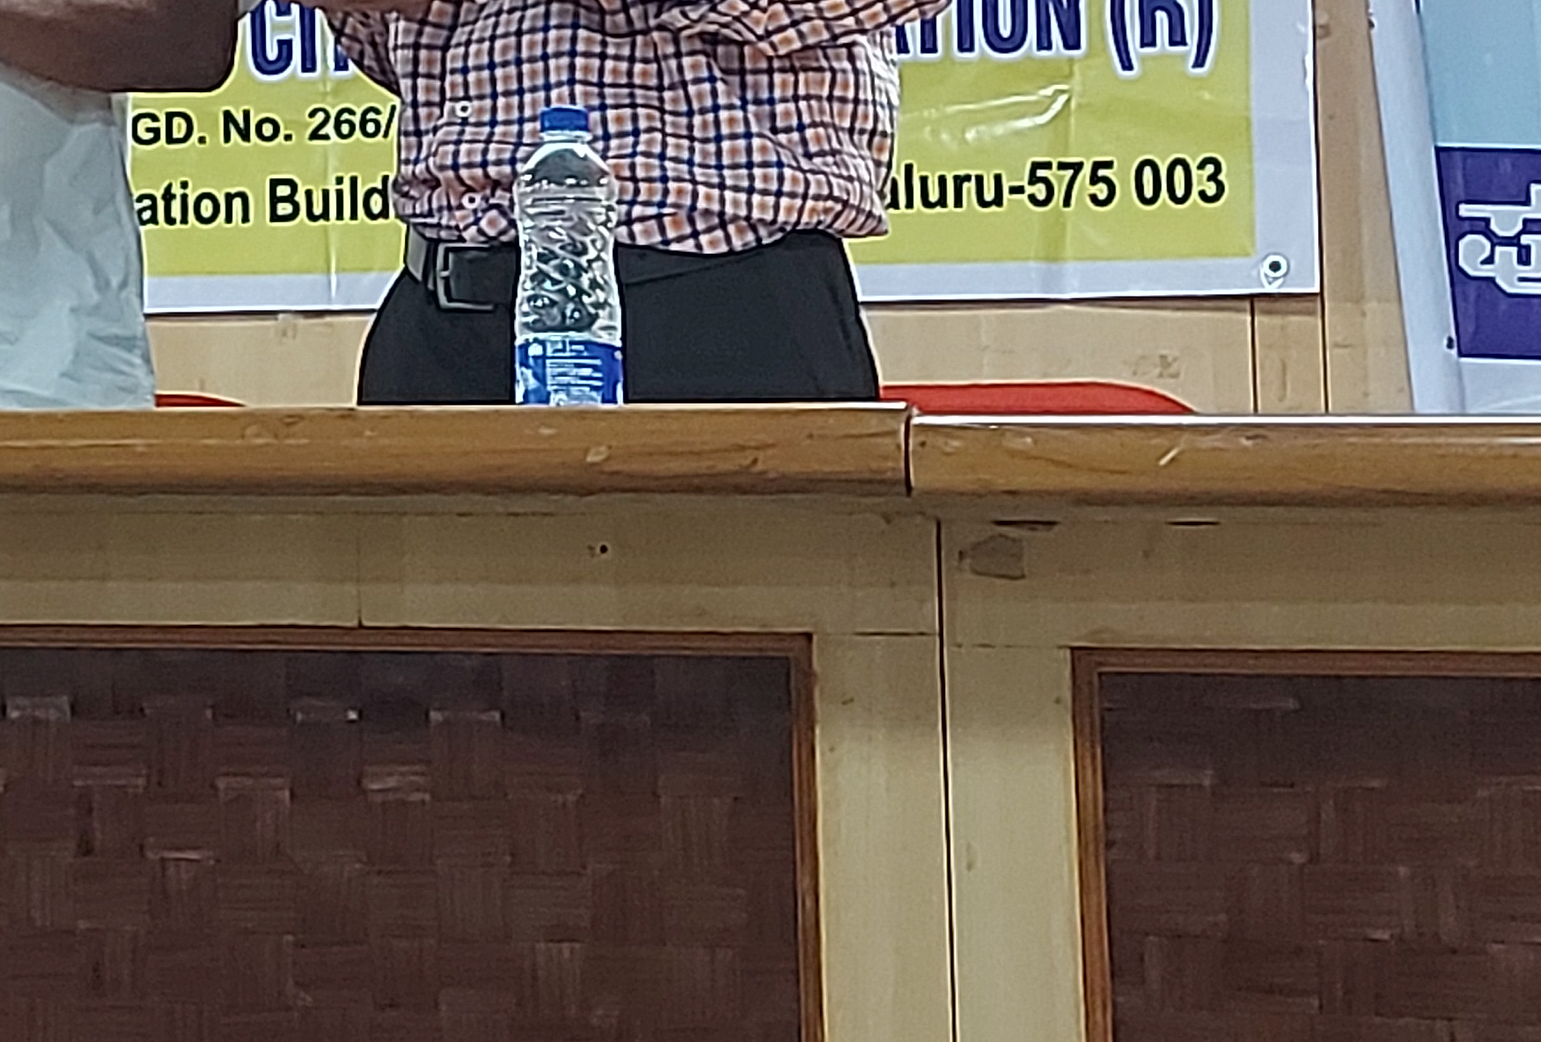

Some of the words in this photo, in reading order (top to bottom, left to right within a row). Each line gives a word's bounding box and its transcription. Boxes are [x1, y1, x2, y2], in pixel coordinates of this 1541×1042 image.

[223, 109, 293, 144] No.
[307, 104, 396, 141] 266/
[1135, 158, 1226, 206] 003
